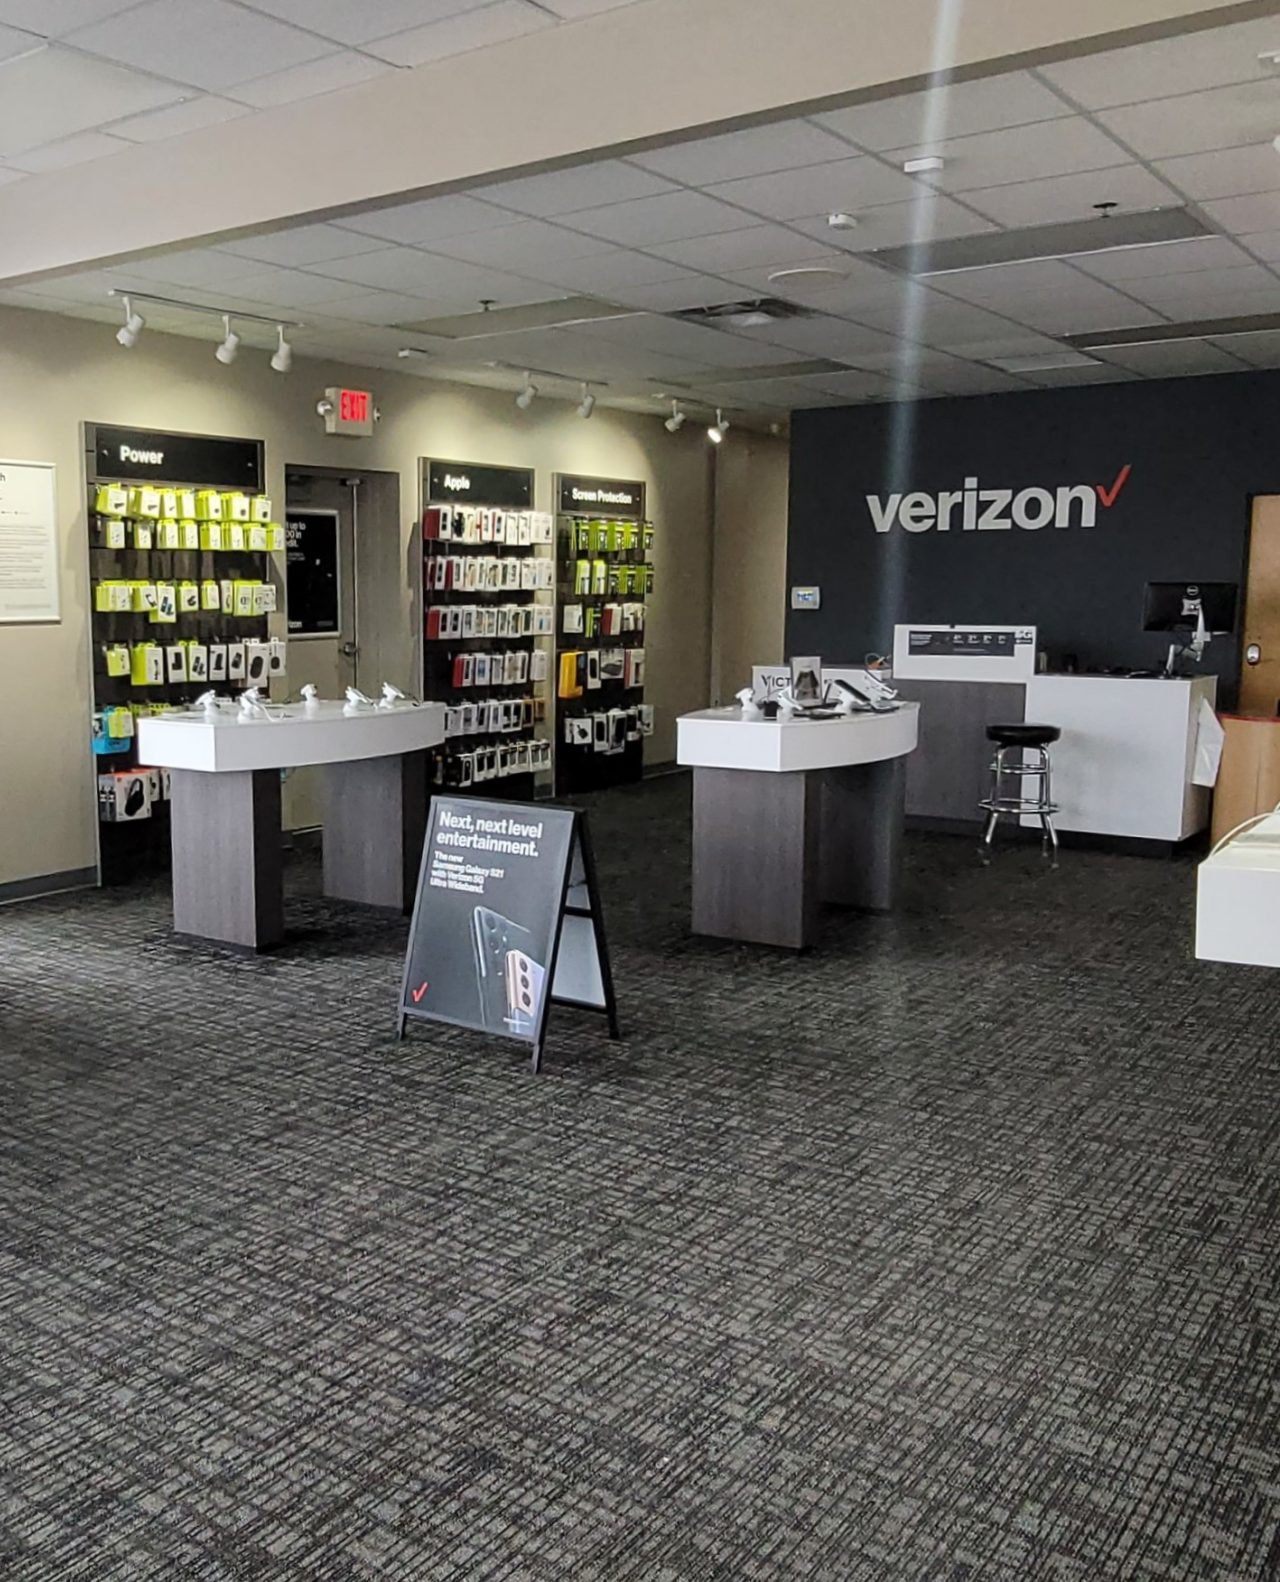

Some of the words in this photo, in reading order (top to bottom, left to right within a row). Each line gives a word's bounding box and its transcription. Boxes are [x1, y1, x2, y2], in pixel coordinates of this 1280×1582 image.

[340, 390, 368, 422] EXIT
[120, 445, 164, 464] Power
[444, 474, 470, 491] Apple
[572, 487, 597, 502] Screen
[597, 489, 632, 504] Protection
[866, 477, 1096, 533] verizon
[439, 811, 475, 833] Next,
[476, 819, 507, 834] next
[508, 819, 543, 838] level
[436, 831, 539, 857] entertainment.
[434, 850, 448, 861] The
[448, 855, 464, 863] new
[465, 864, 489, 877] Galaxy
